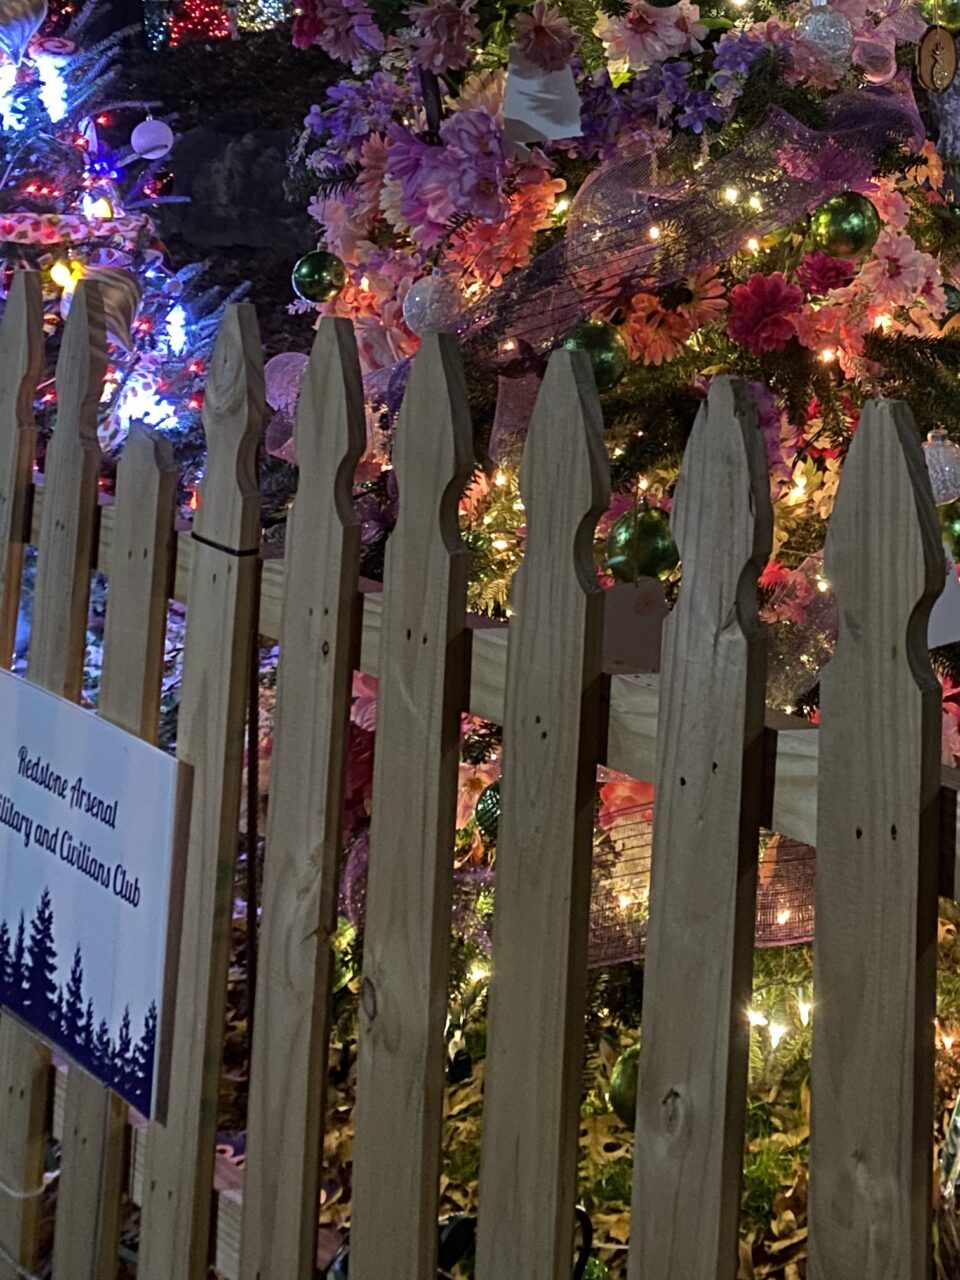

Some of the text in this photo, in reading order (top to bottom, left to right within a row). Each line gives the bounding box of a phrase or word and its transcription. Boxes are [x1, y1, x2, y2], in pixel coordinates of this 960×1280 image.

[18, 745, 119, 829] Redstone Arsenal
[0, 793, 141, 908] ilitary and Civilians Club
